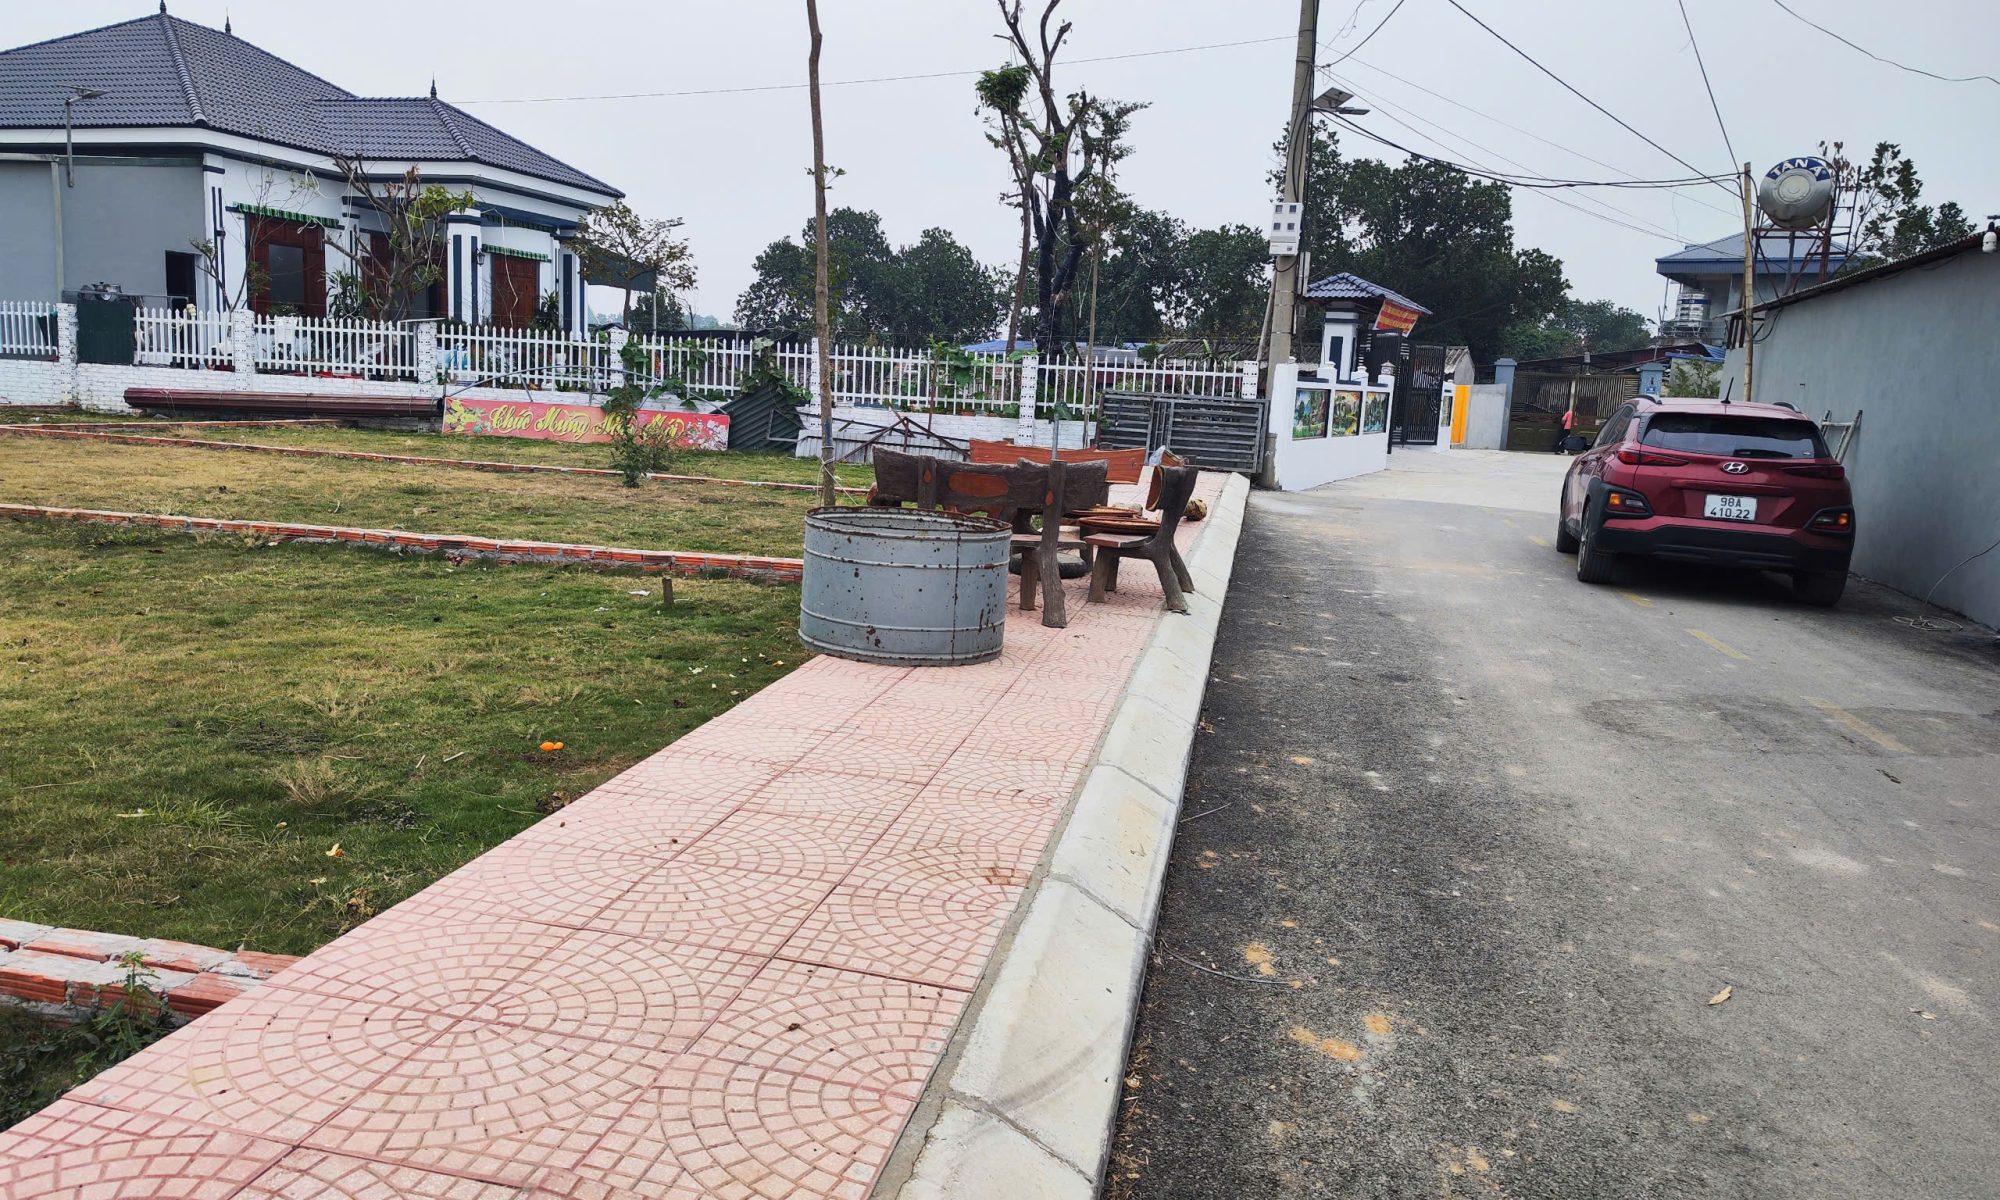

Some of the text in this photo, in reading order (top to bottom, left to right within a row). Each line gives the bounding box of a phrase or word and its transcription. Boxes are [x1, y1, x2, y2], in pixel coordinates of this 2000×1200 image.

[490, 404, 534, 434] Chúc
[1720, 497, 1742, 508] 98A
[1710, 506, 1750, 519] 410.22
